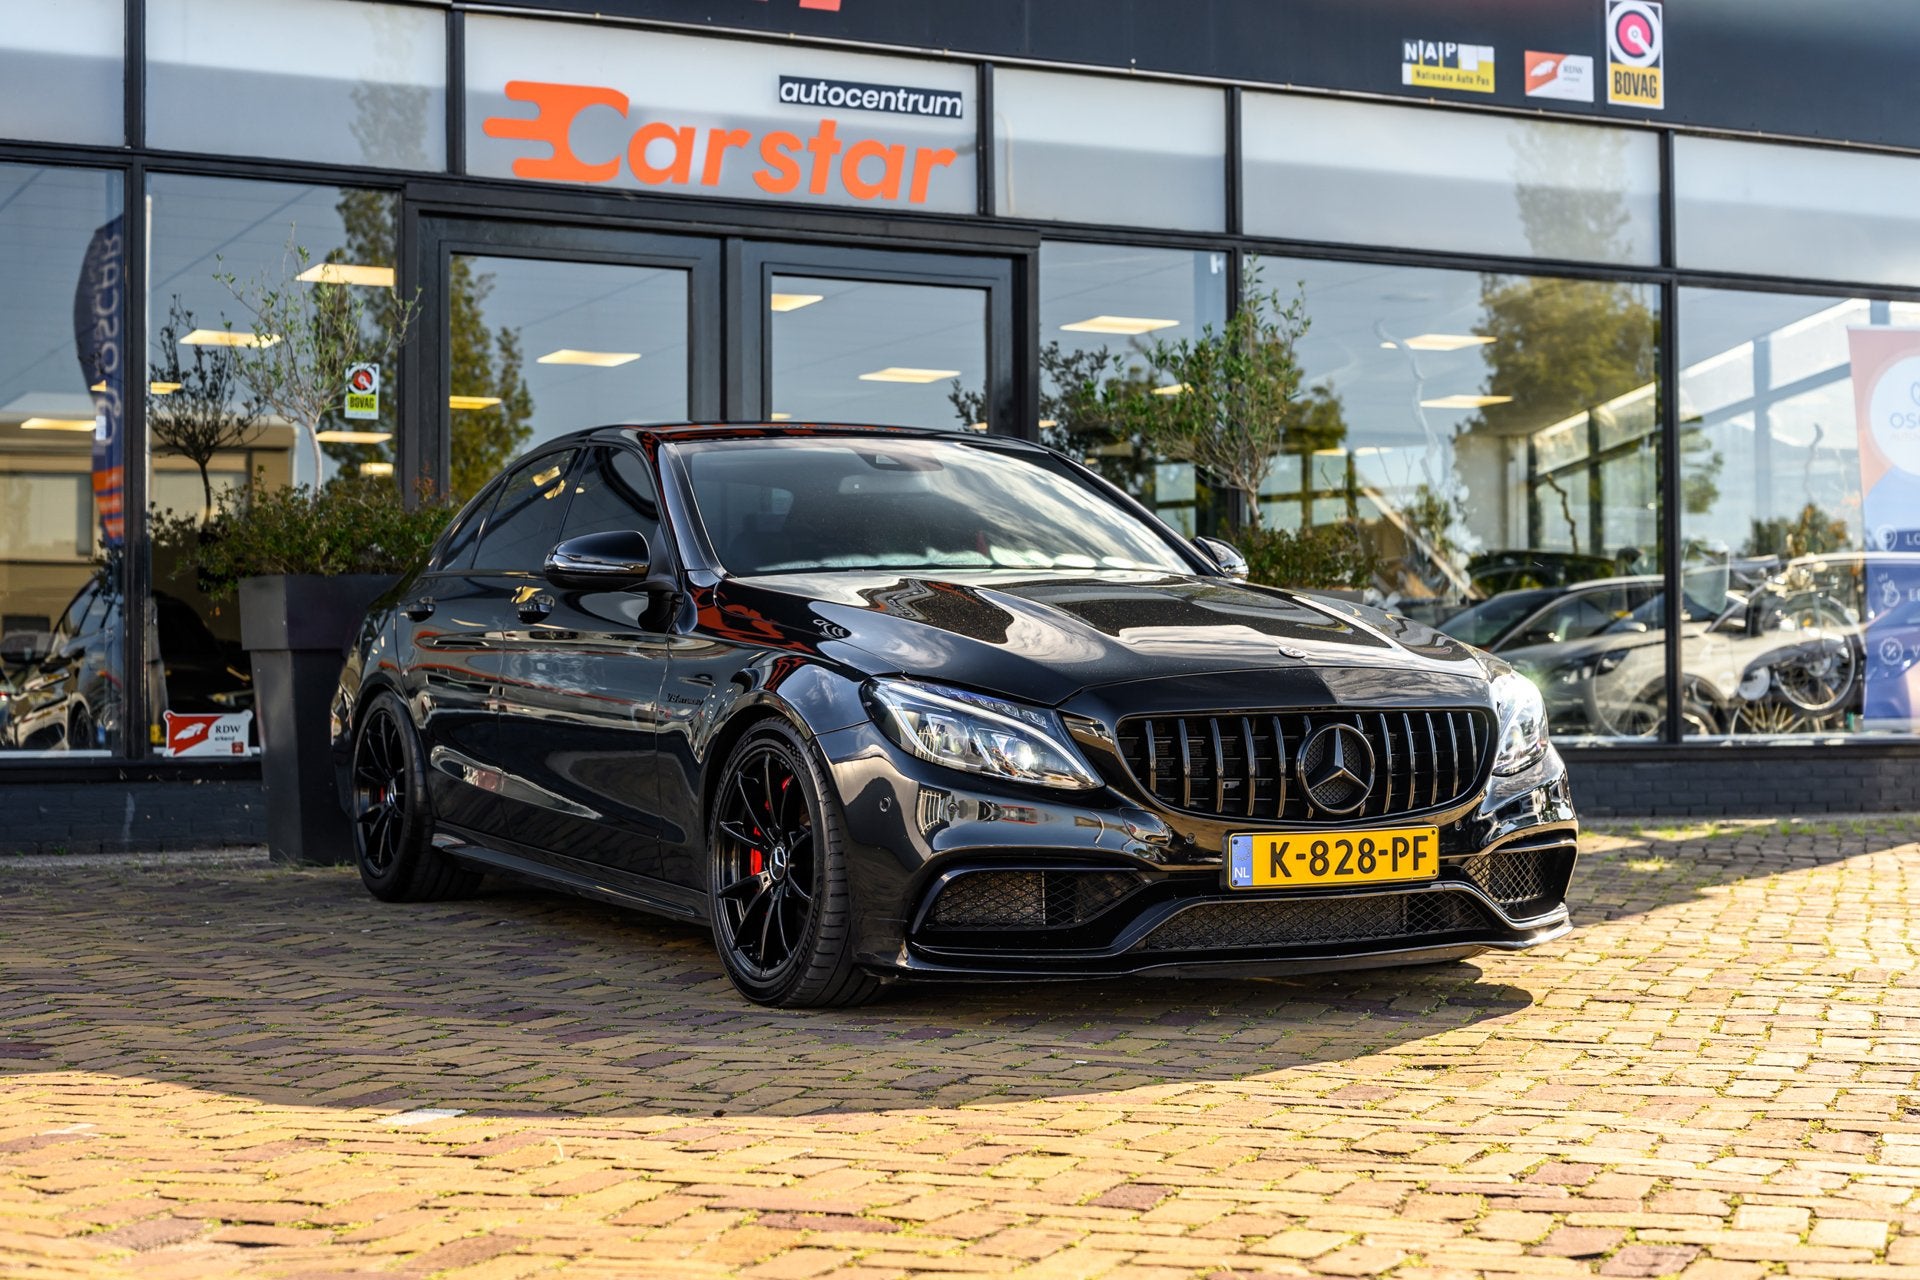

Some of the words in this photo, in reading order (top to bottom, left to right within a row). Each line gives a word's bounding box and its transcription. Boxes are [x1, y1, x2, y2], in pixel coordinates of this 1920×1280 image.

[1614, 70, 1657, 99] BOVAG
[780, 78, 962, 117] autocentrum
[482, 80, 957, 203] Carstar
[350, 396, 375, 409] BOVAG
[1889, 412, 1920, 429] OS
[215, 724, 241, 734] RDW
[1270, 835, 1429, 878] K-828-PF
[1234, 867, 1250, 879] NL
